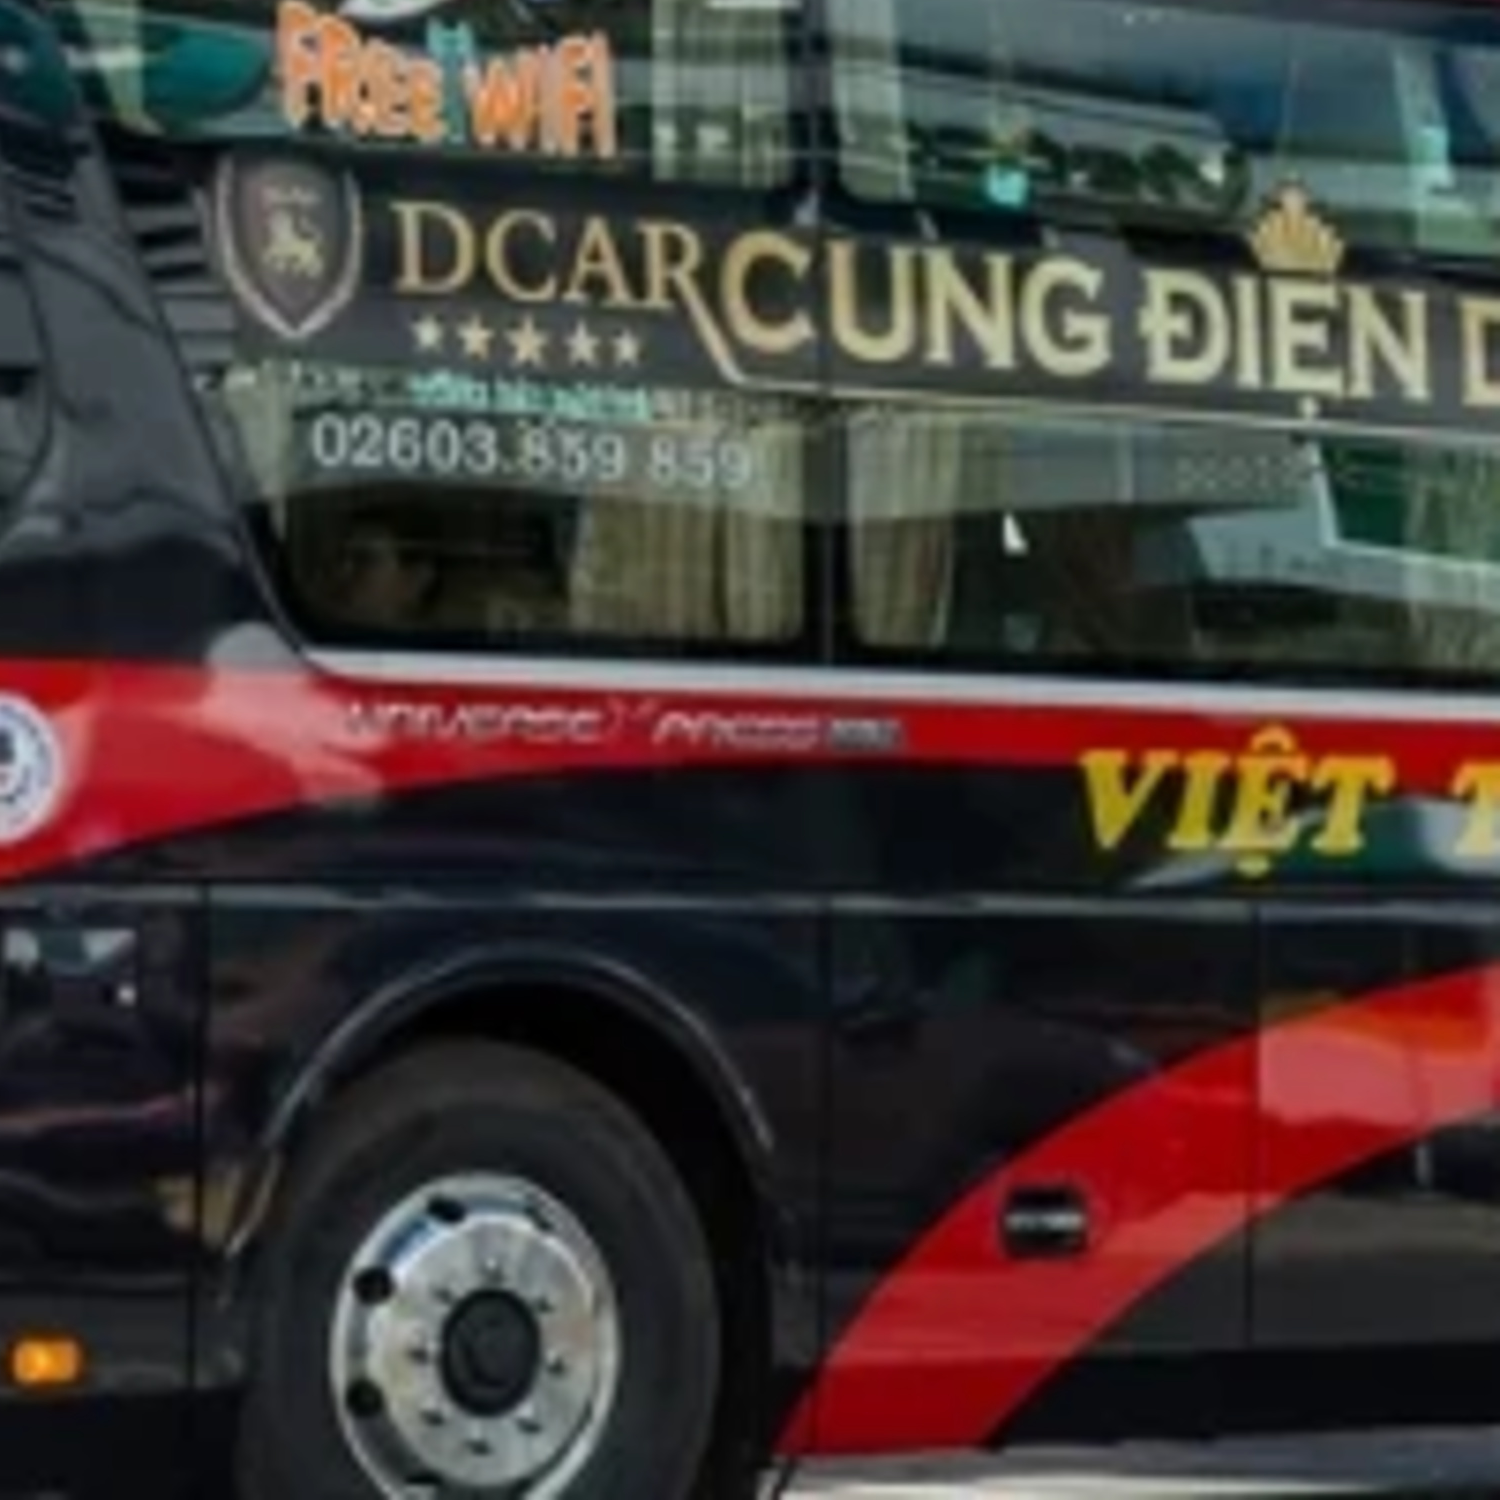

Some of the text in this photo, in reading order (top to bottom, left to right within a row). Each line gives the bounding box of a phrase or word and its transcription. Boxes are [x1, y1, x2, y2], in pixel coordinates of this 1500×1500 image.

[391, 201, 706, 315] DCAR
[719, 231, 1112, 376] CUNG
[1080, 722, 1396, 878] VIỆT
